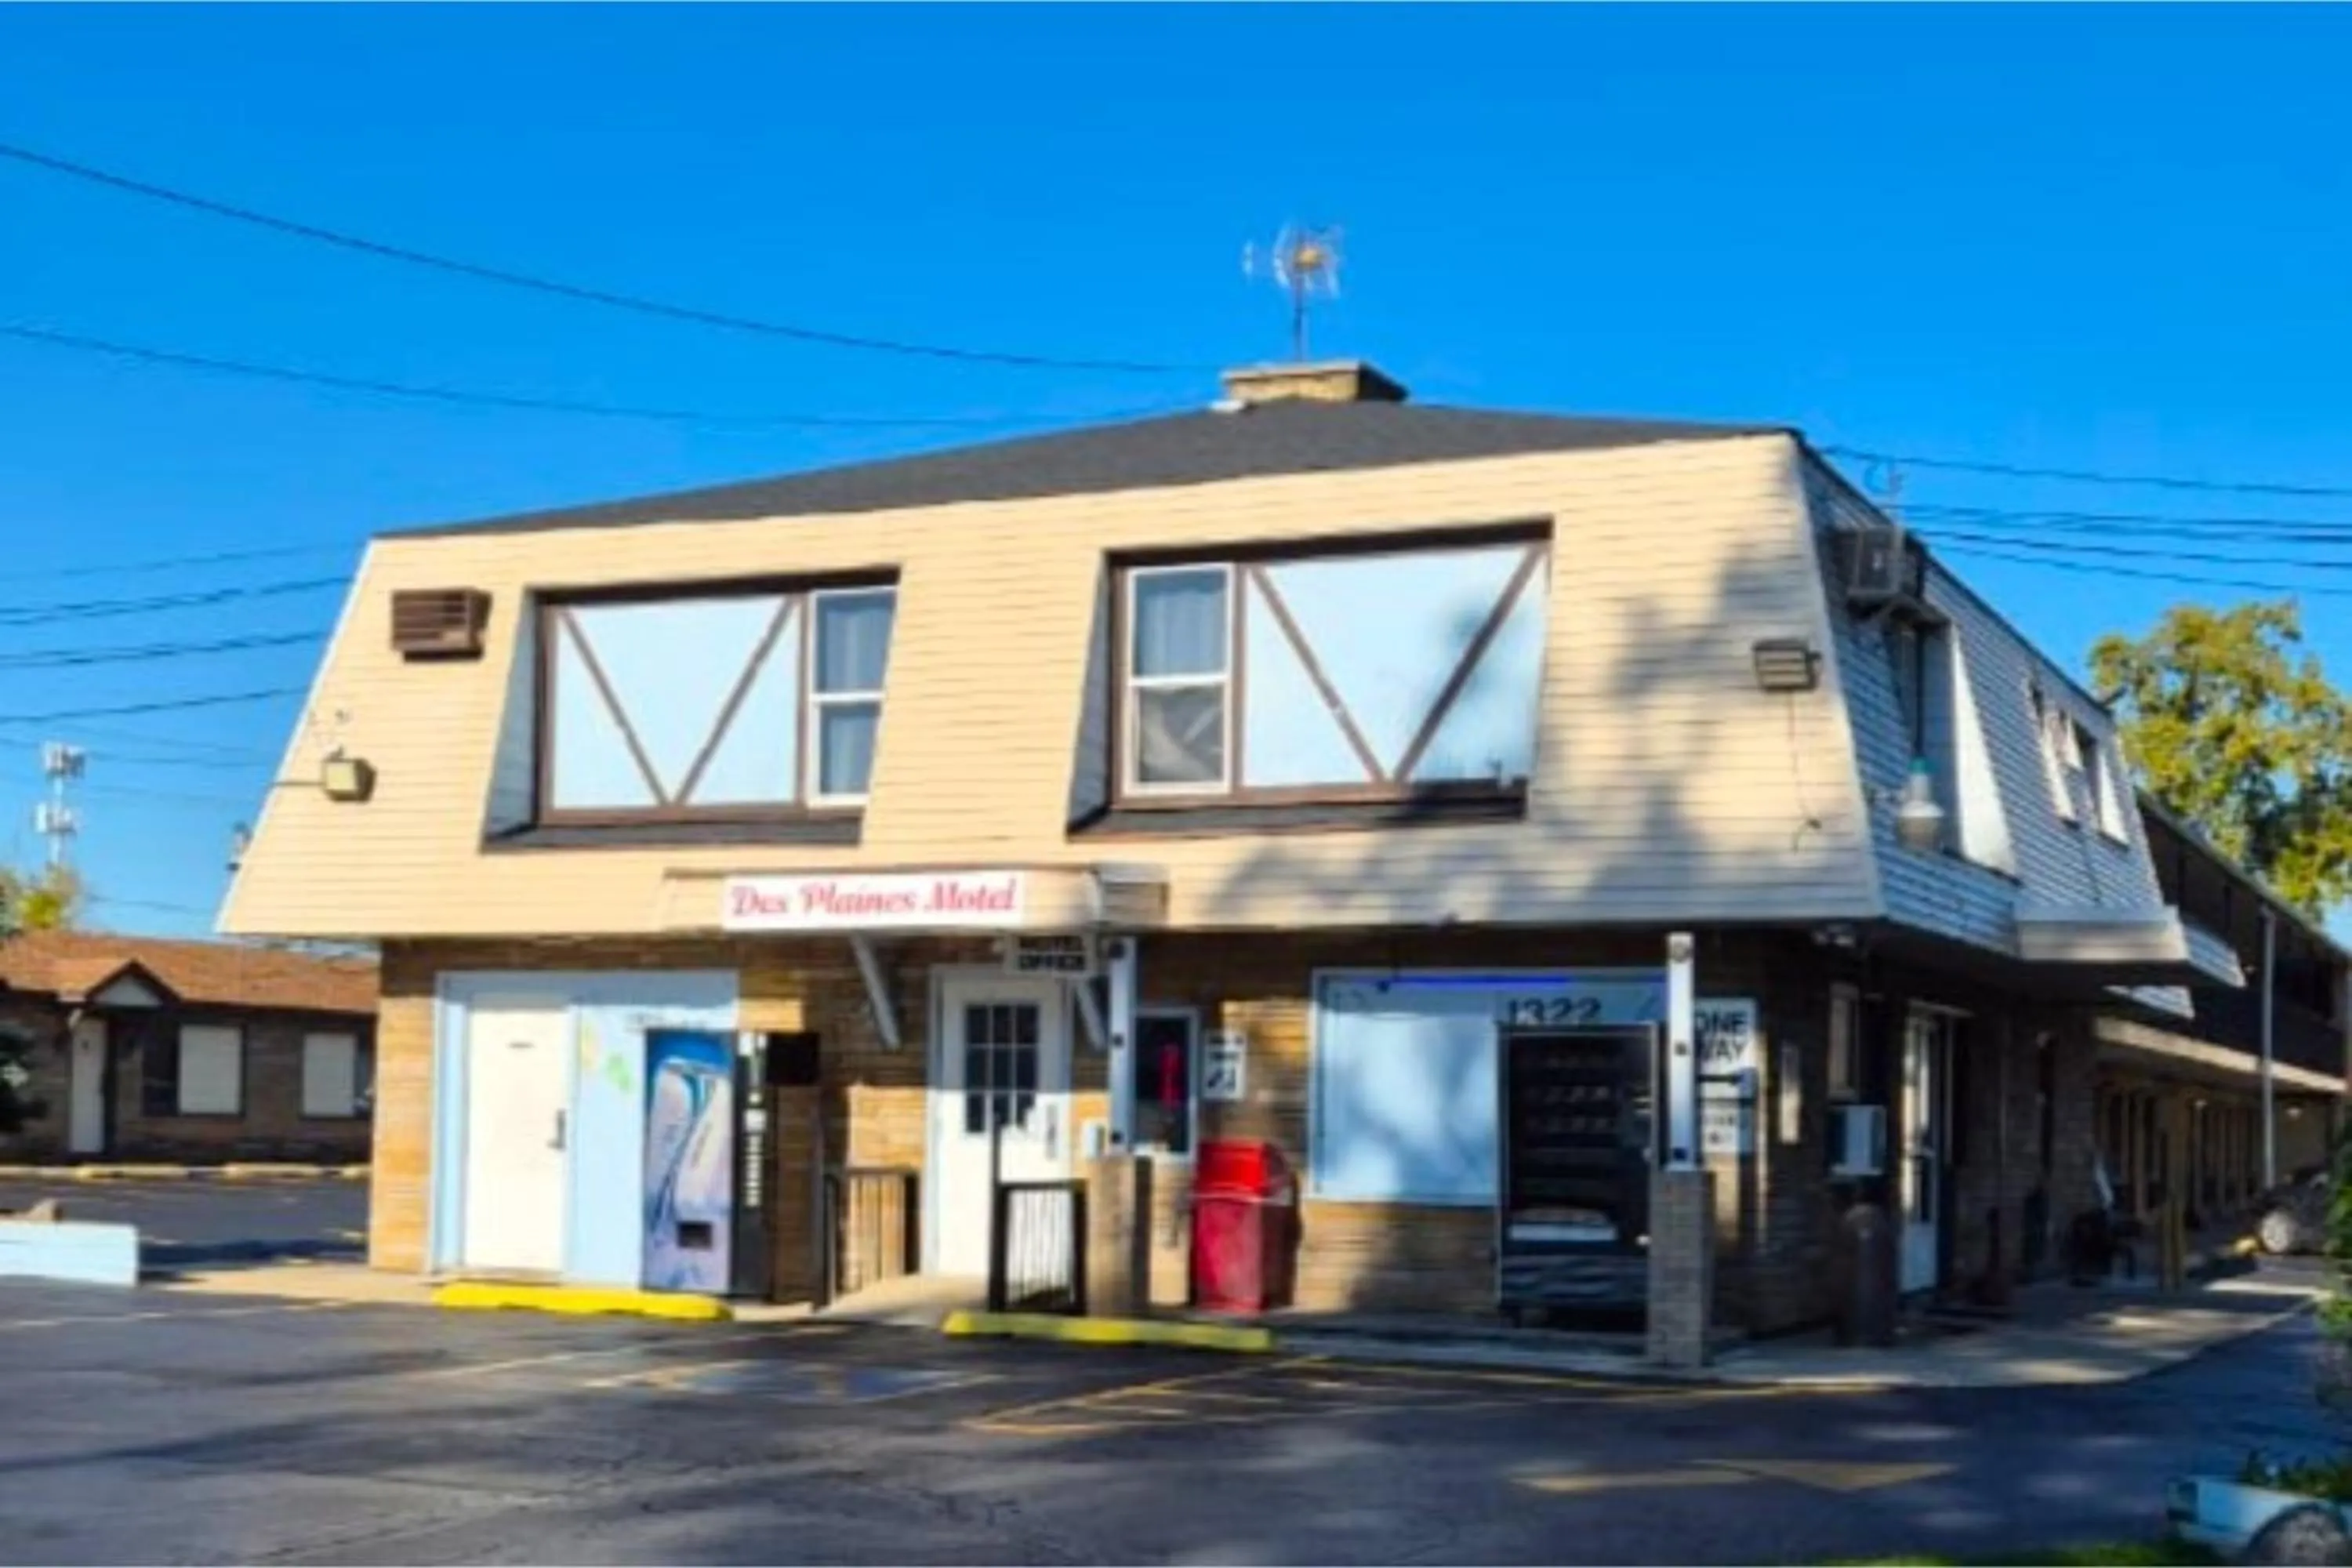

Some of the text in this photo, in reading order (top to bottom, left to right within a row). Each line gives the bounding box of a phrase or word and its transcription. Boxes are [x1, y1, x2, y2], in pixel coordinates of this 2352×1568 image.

[731, 877, 1017, 916] Des Plaines Motel
[1018, 953, 1086, 971] OFFICE
